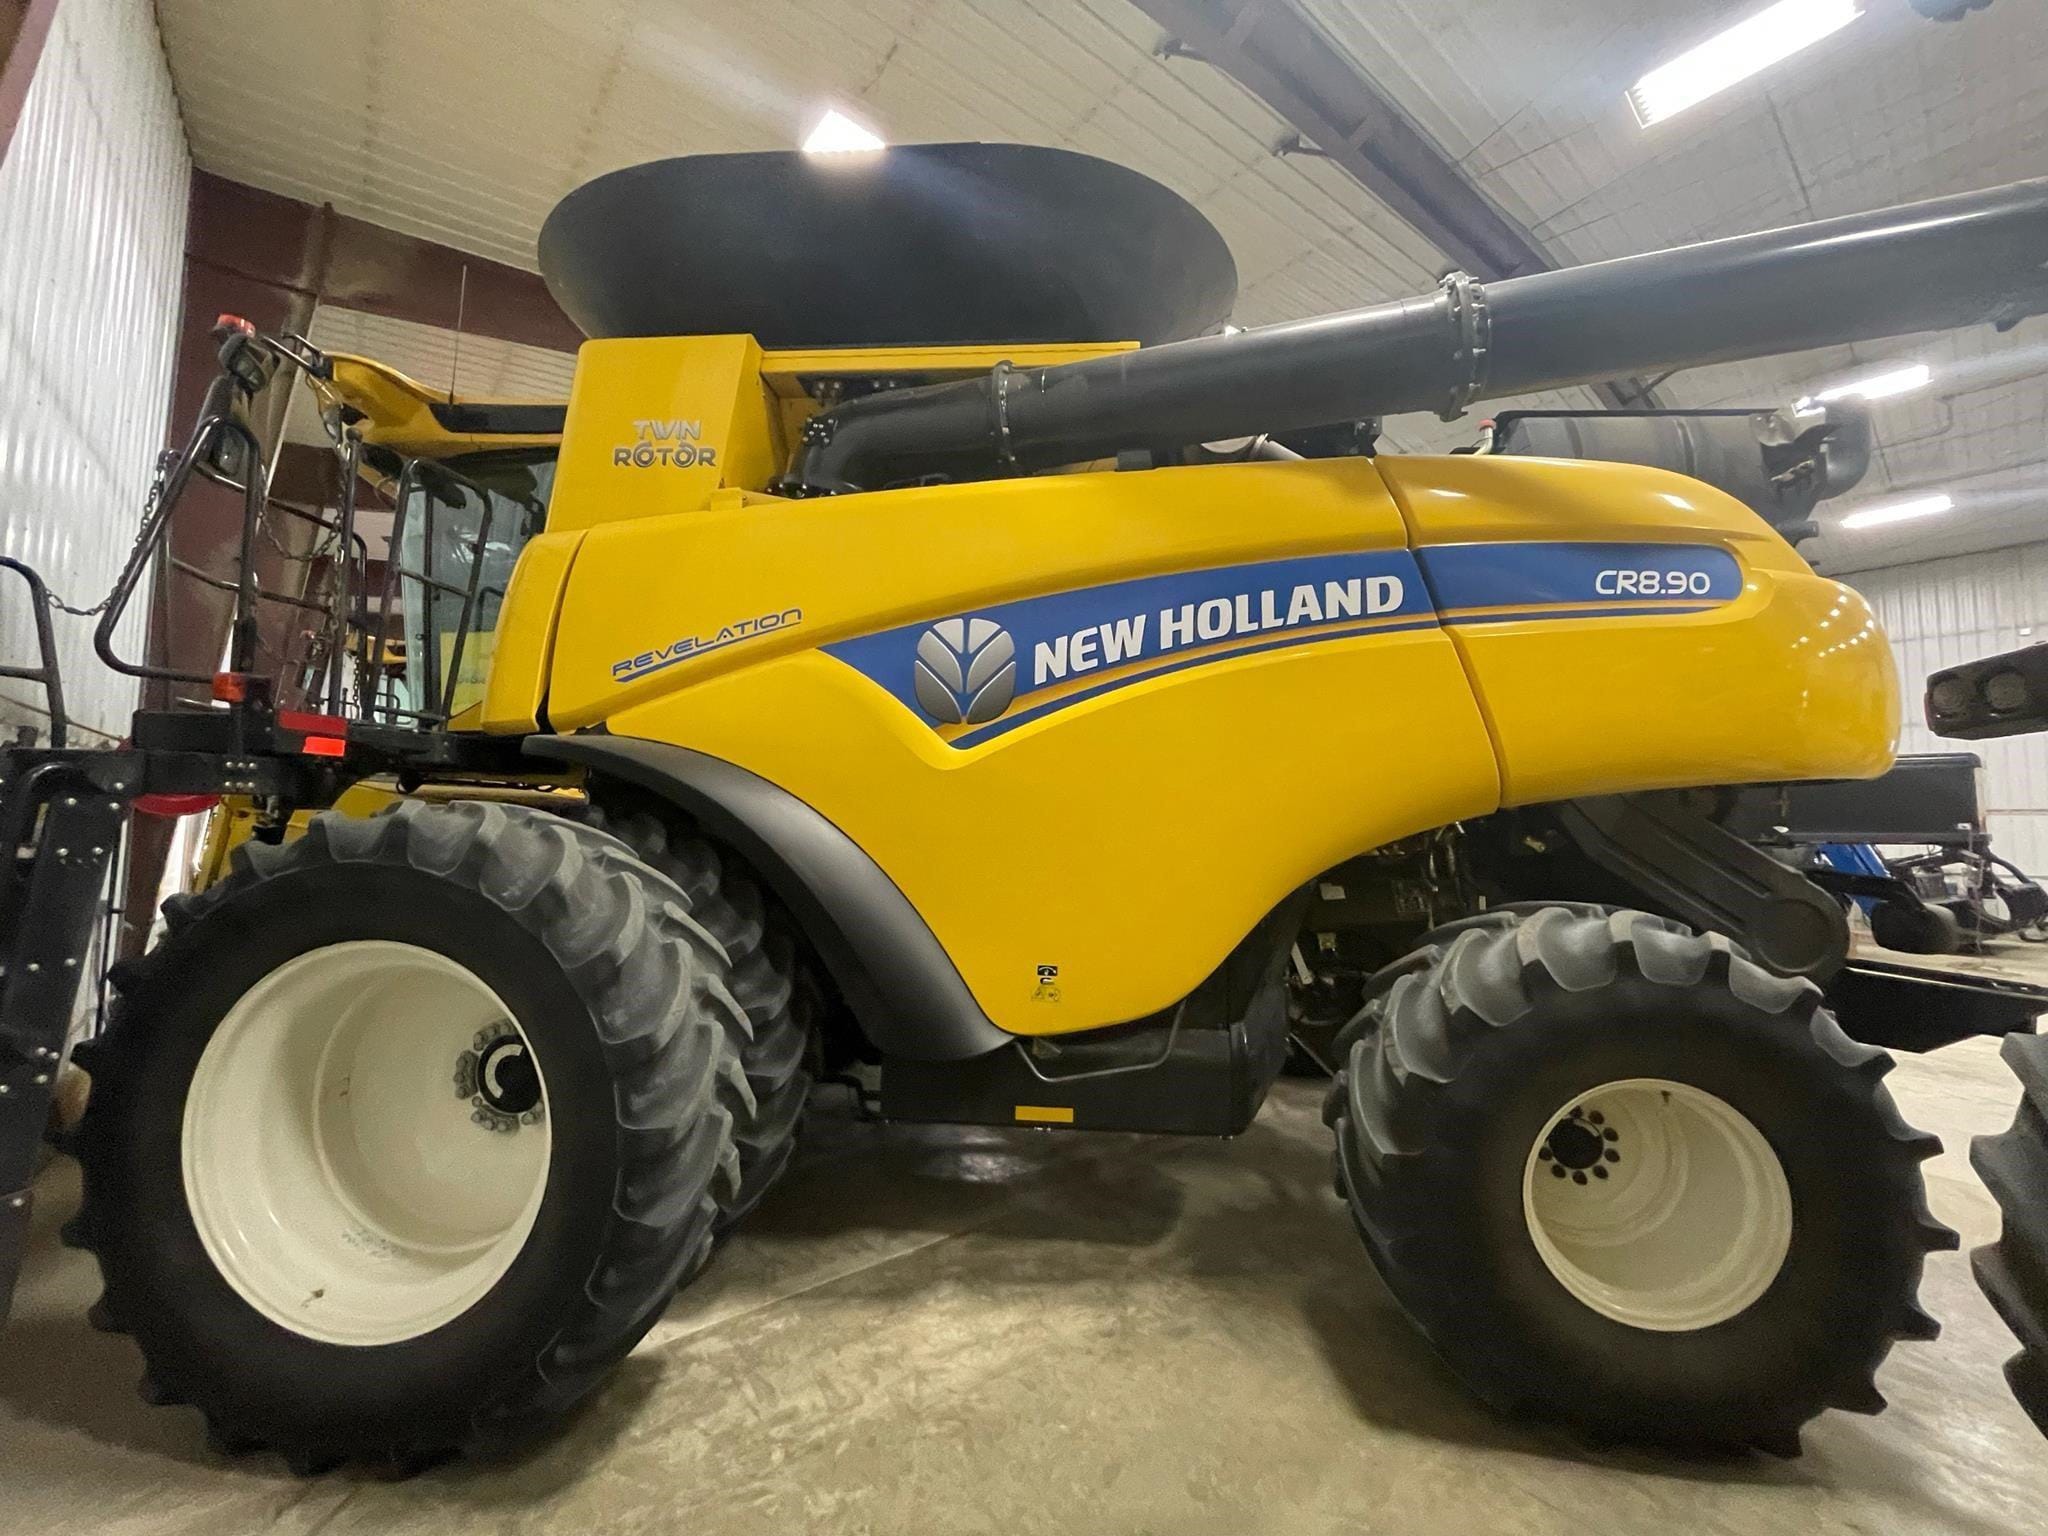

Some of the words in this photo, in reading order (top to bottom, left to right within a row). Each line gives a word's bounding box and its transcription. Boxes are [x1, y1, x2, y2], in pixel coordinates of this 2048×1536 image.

[633, 420, 701, 440] TWIN
[613, 441, 716, 467] ROTOR
[1595, 570, 1711, 594] CR8.90
[612, 608, 802, 676] REVELATION
[1034, 614, 1146, 685] NEW
[1160, 575, 1404, 650] HOLLAND
